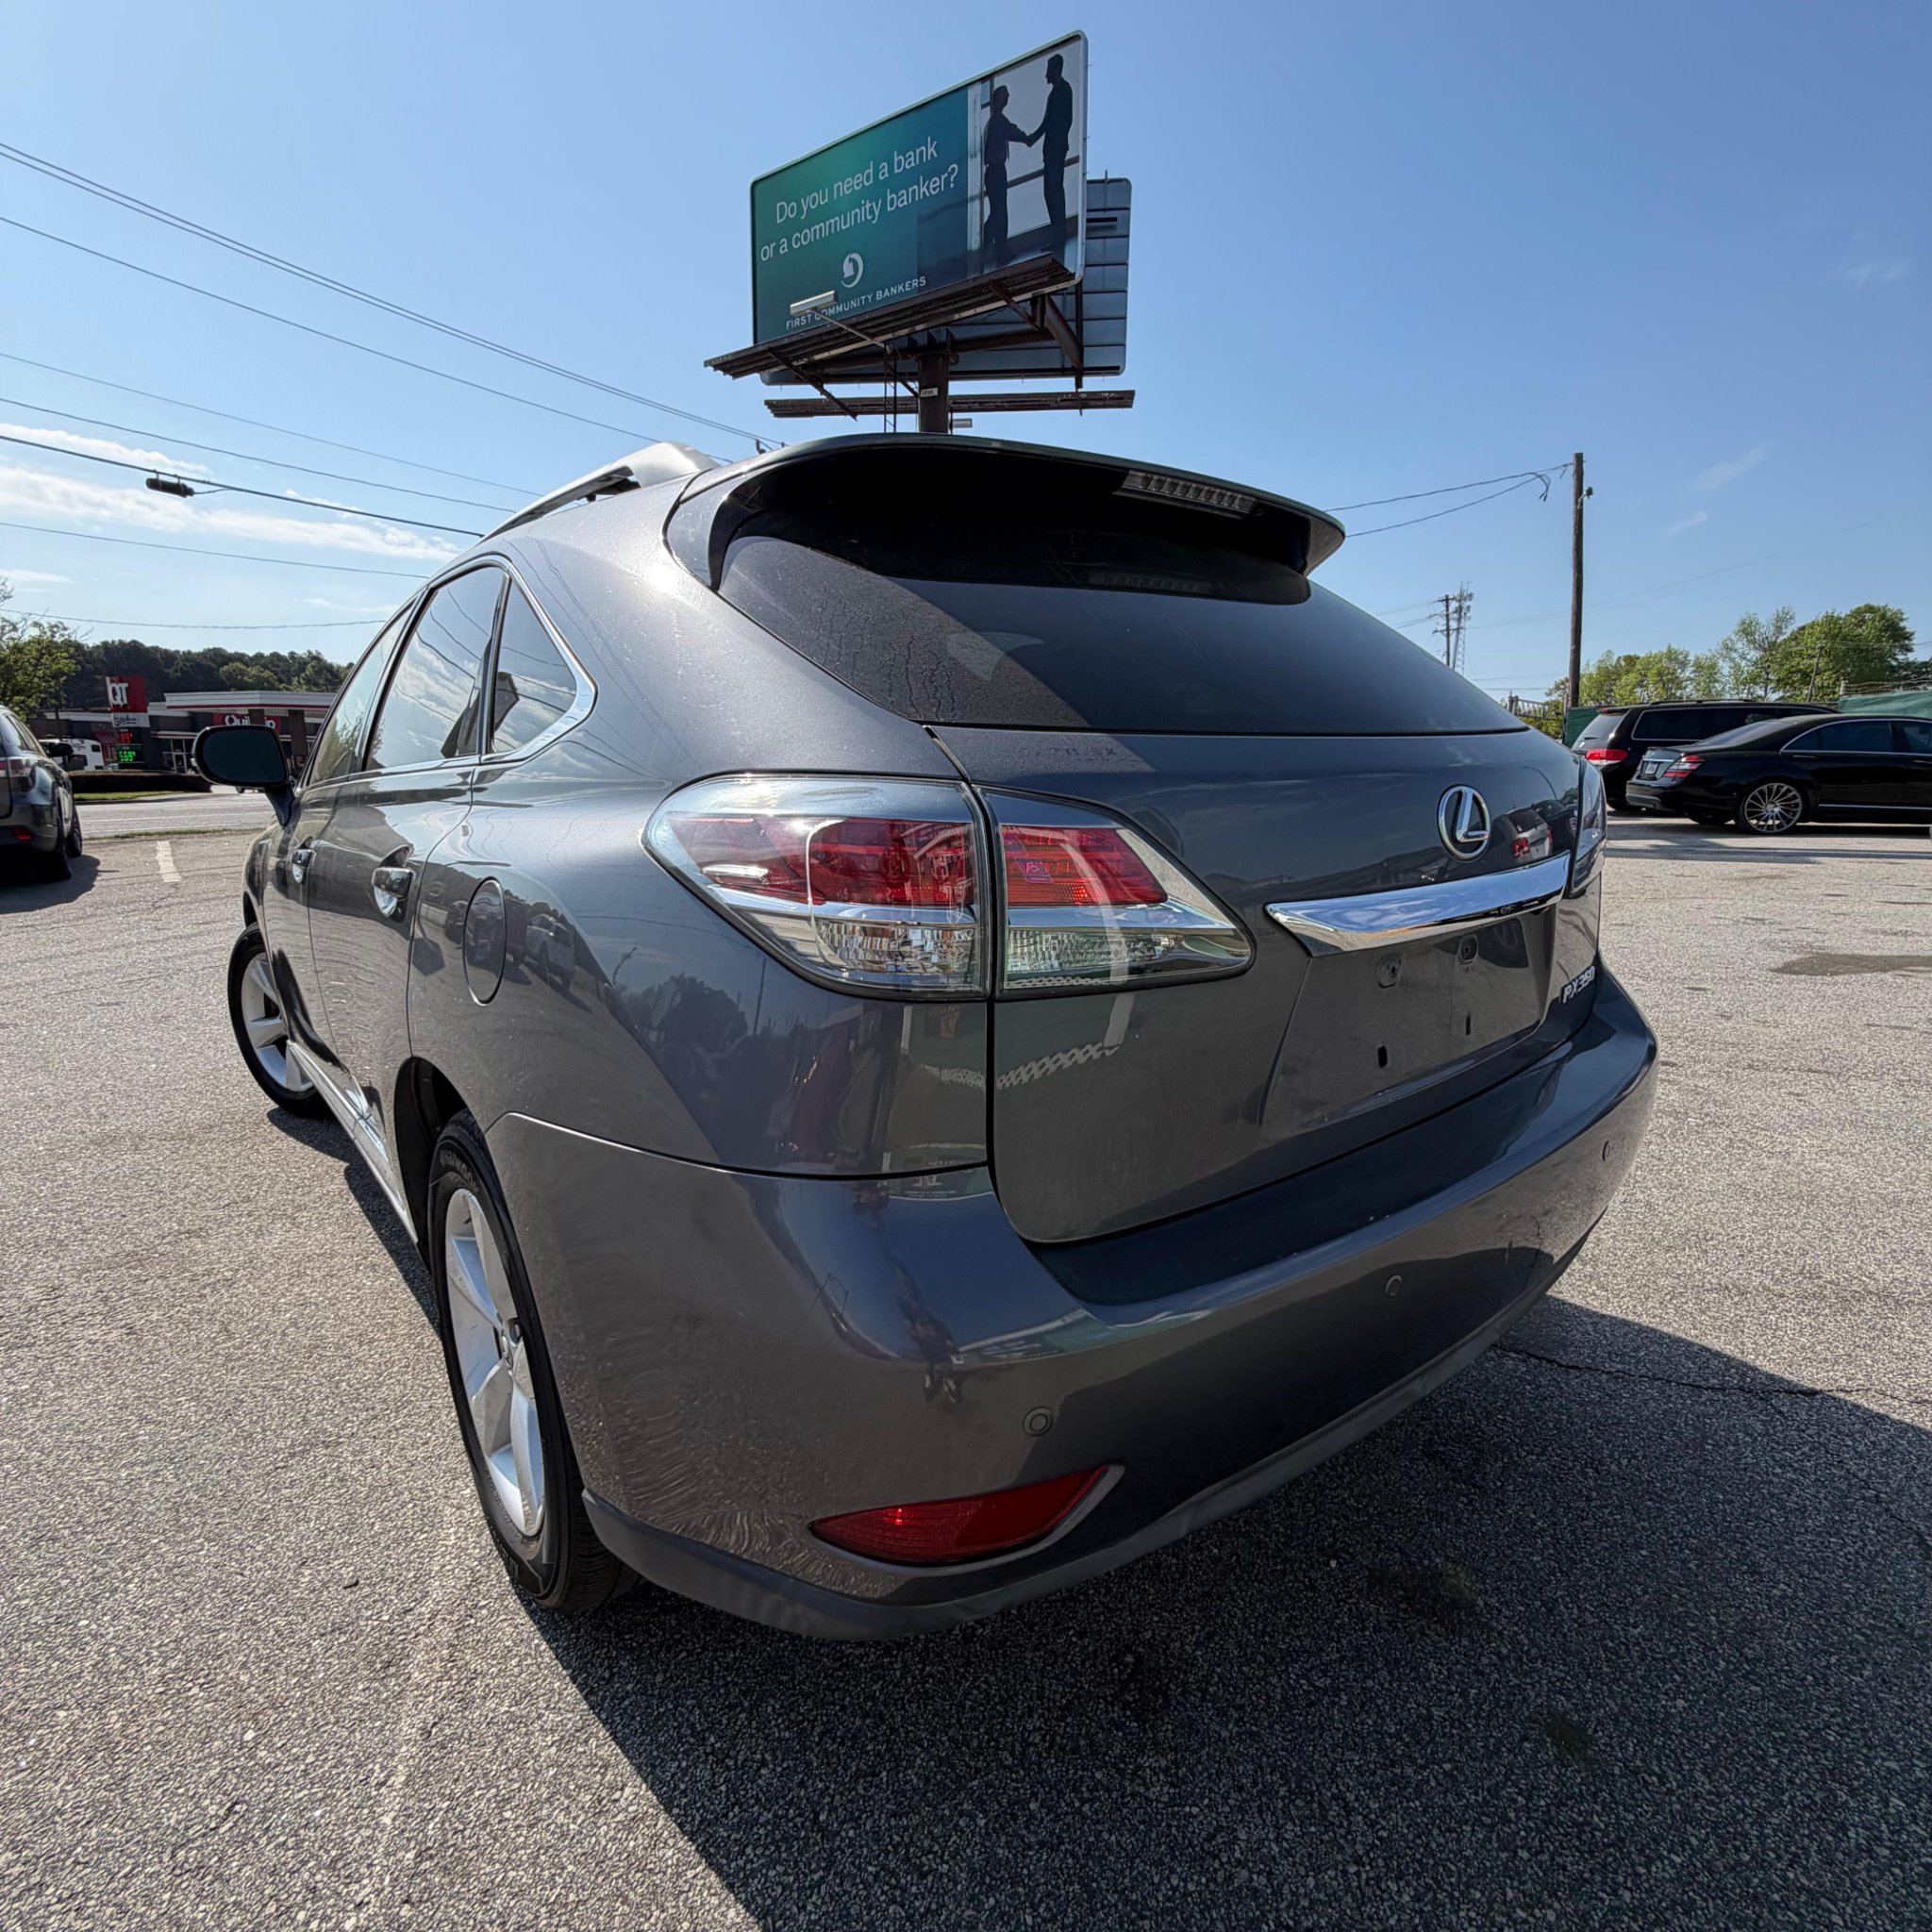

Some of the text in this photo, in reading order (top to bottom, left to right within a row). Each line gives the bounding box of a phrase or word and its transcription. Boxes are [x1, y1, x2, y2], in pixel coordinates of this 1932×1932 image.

[760, 163, 958, 261] or a community banker?
[776, 136, 939, 224] Do you need a bank
[786, 313, 812, 330] FIRST
[876, 276, 926, 301] BANKERS
[110, 682, 128, 708] QT
